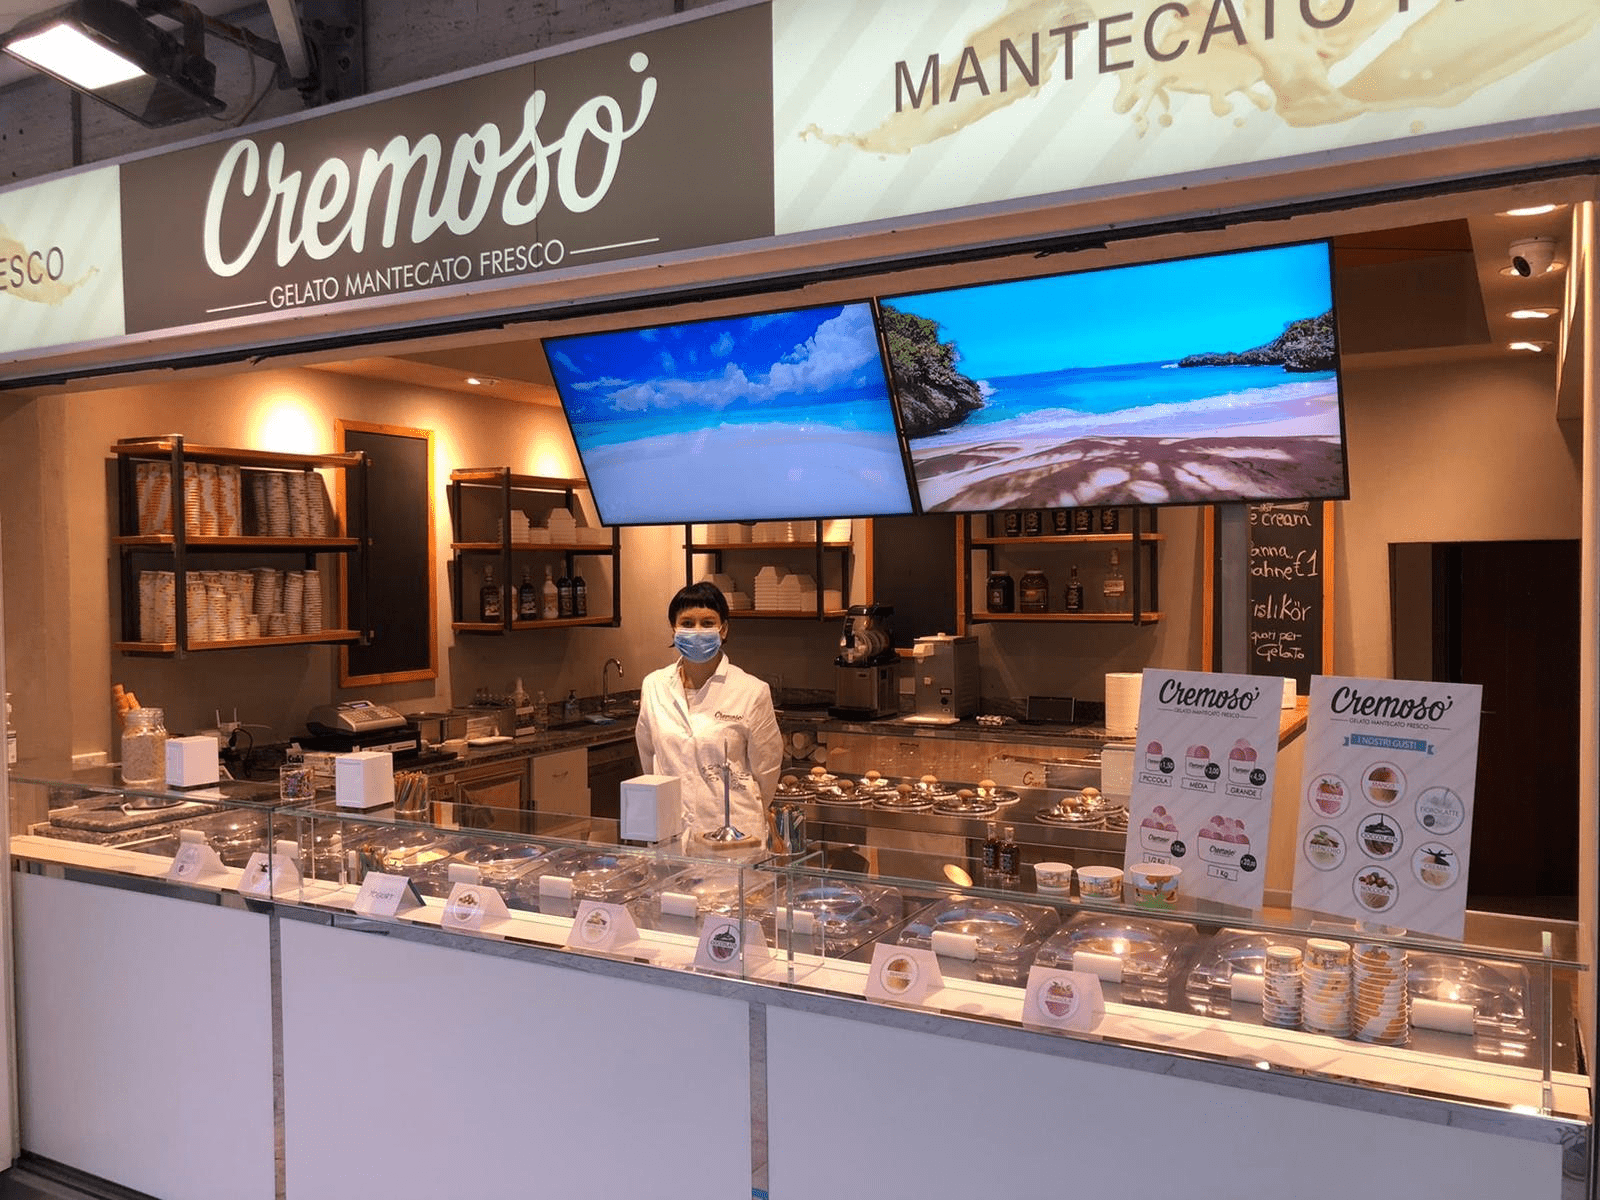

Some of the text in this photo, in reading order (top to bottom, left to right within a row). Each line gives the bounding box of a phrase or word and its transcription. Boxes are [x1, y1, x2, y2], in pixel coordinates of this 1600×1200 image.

[269, 239, 566, 309] GELATO MANTECATO FRESCO
[1261, 513, 1312, 527] cream
[1250, 541, 1293, 559] anna
[1250, 560, 1293, 580] ahne
[1349, 717, 1370, 725] GELATO
[1371, 719, 1405, 728] MANTECATO
[1361, 737, 1391, 747] NOSTRI
[1143, 775, 1168, 785] PICCOLA
[1189, 781, 1208, 790] MEDIA
[1230, 787, 1257, 797] GRANDE
